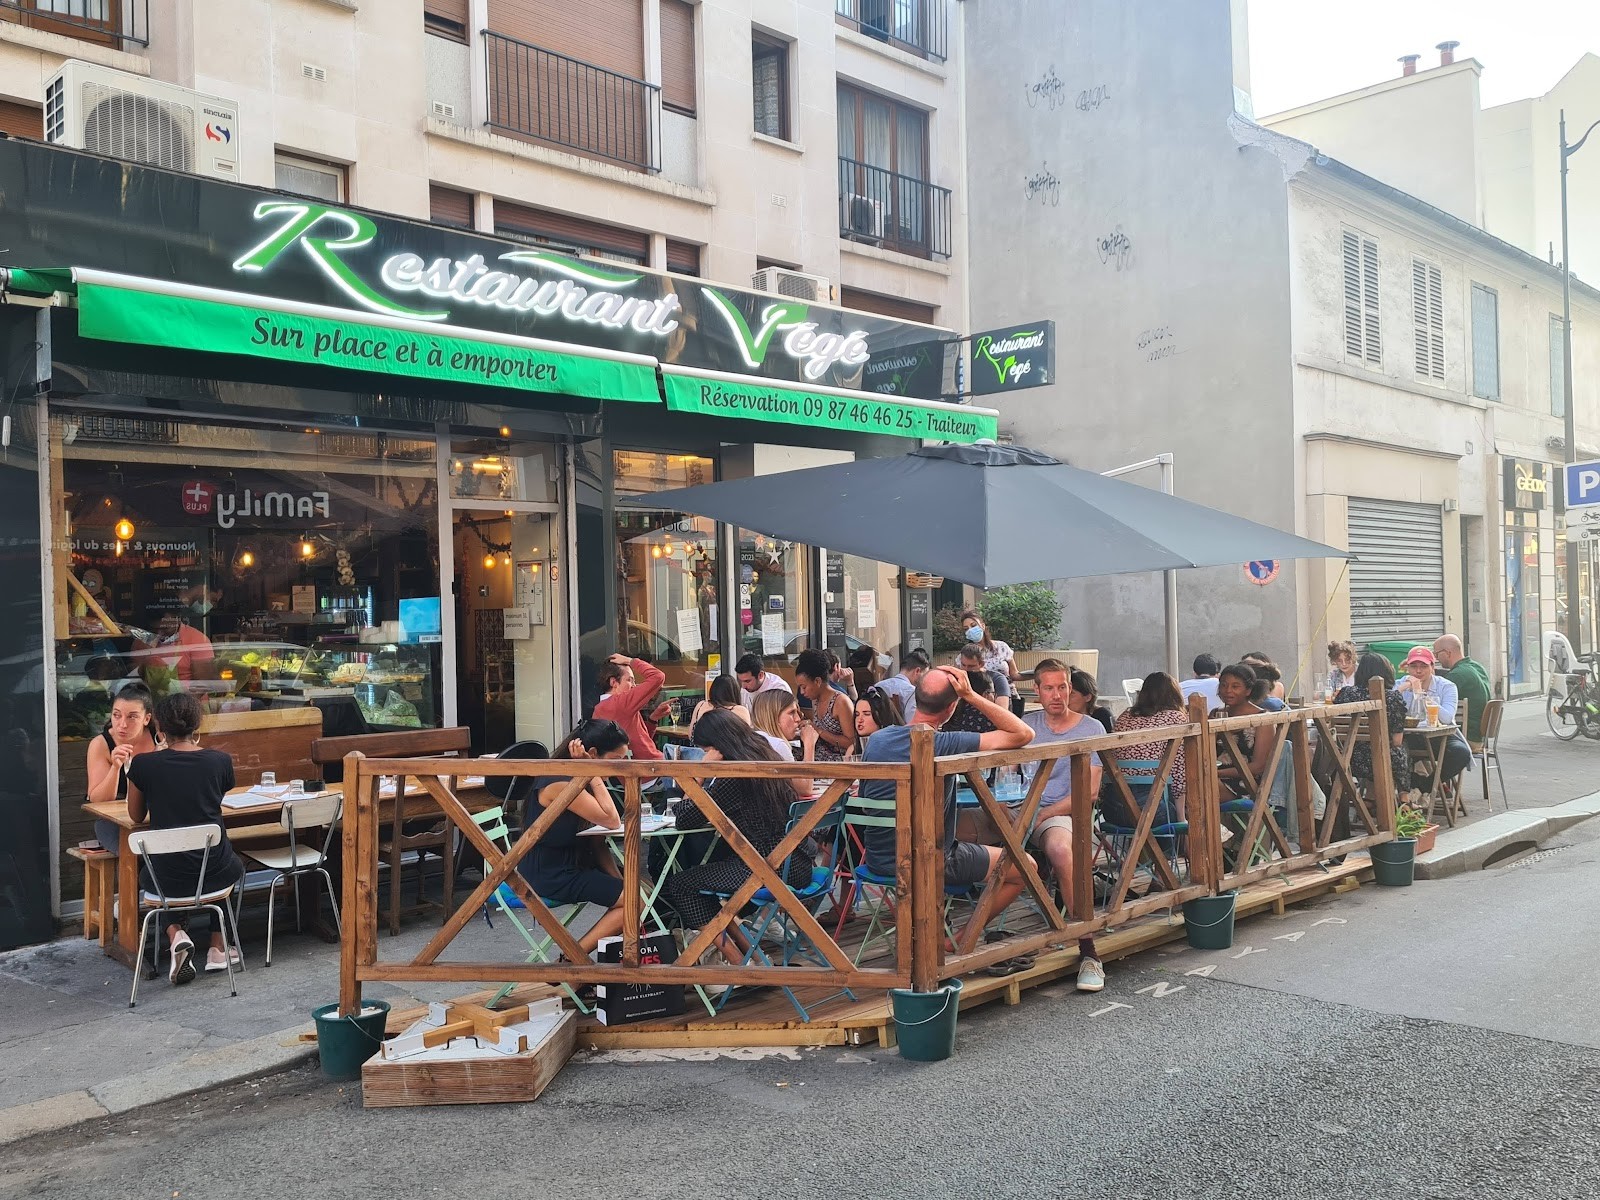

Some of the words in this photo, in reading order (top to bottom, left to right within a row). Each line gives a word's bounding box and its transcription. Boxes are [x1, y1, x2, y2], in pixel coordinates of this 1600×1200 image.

[232, 201, 680, 335] Restaurant
[700, 285, 870, 380] Végé
[251, 317, 304, 349] Sur
[313, 329, 387, 360] place
[395, 341, 419, 363] et
[427, 341, 443, 367] à
[450, 351, 558, 381] emporter
[974, 330, 1044, 360] Restaurant
[700, 384, 800, 415] Réservation
[804, 397, 823, 417] 09
[828, 401, 847, 421] 87
[850, 403, 868, 424] 46
[873, 406, 891, 426] 46
[896, 409, 913, 428] 25
[926, 412, 977, 436] Traiteur
[1516, 476, 1547, 493] GEOX
[1578, 470, 1600, 499] P
[618, 945, 658, 958] SORA
[1088, 917, 1347, 1017] PAYANT
